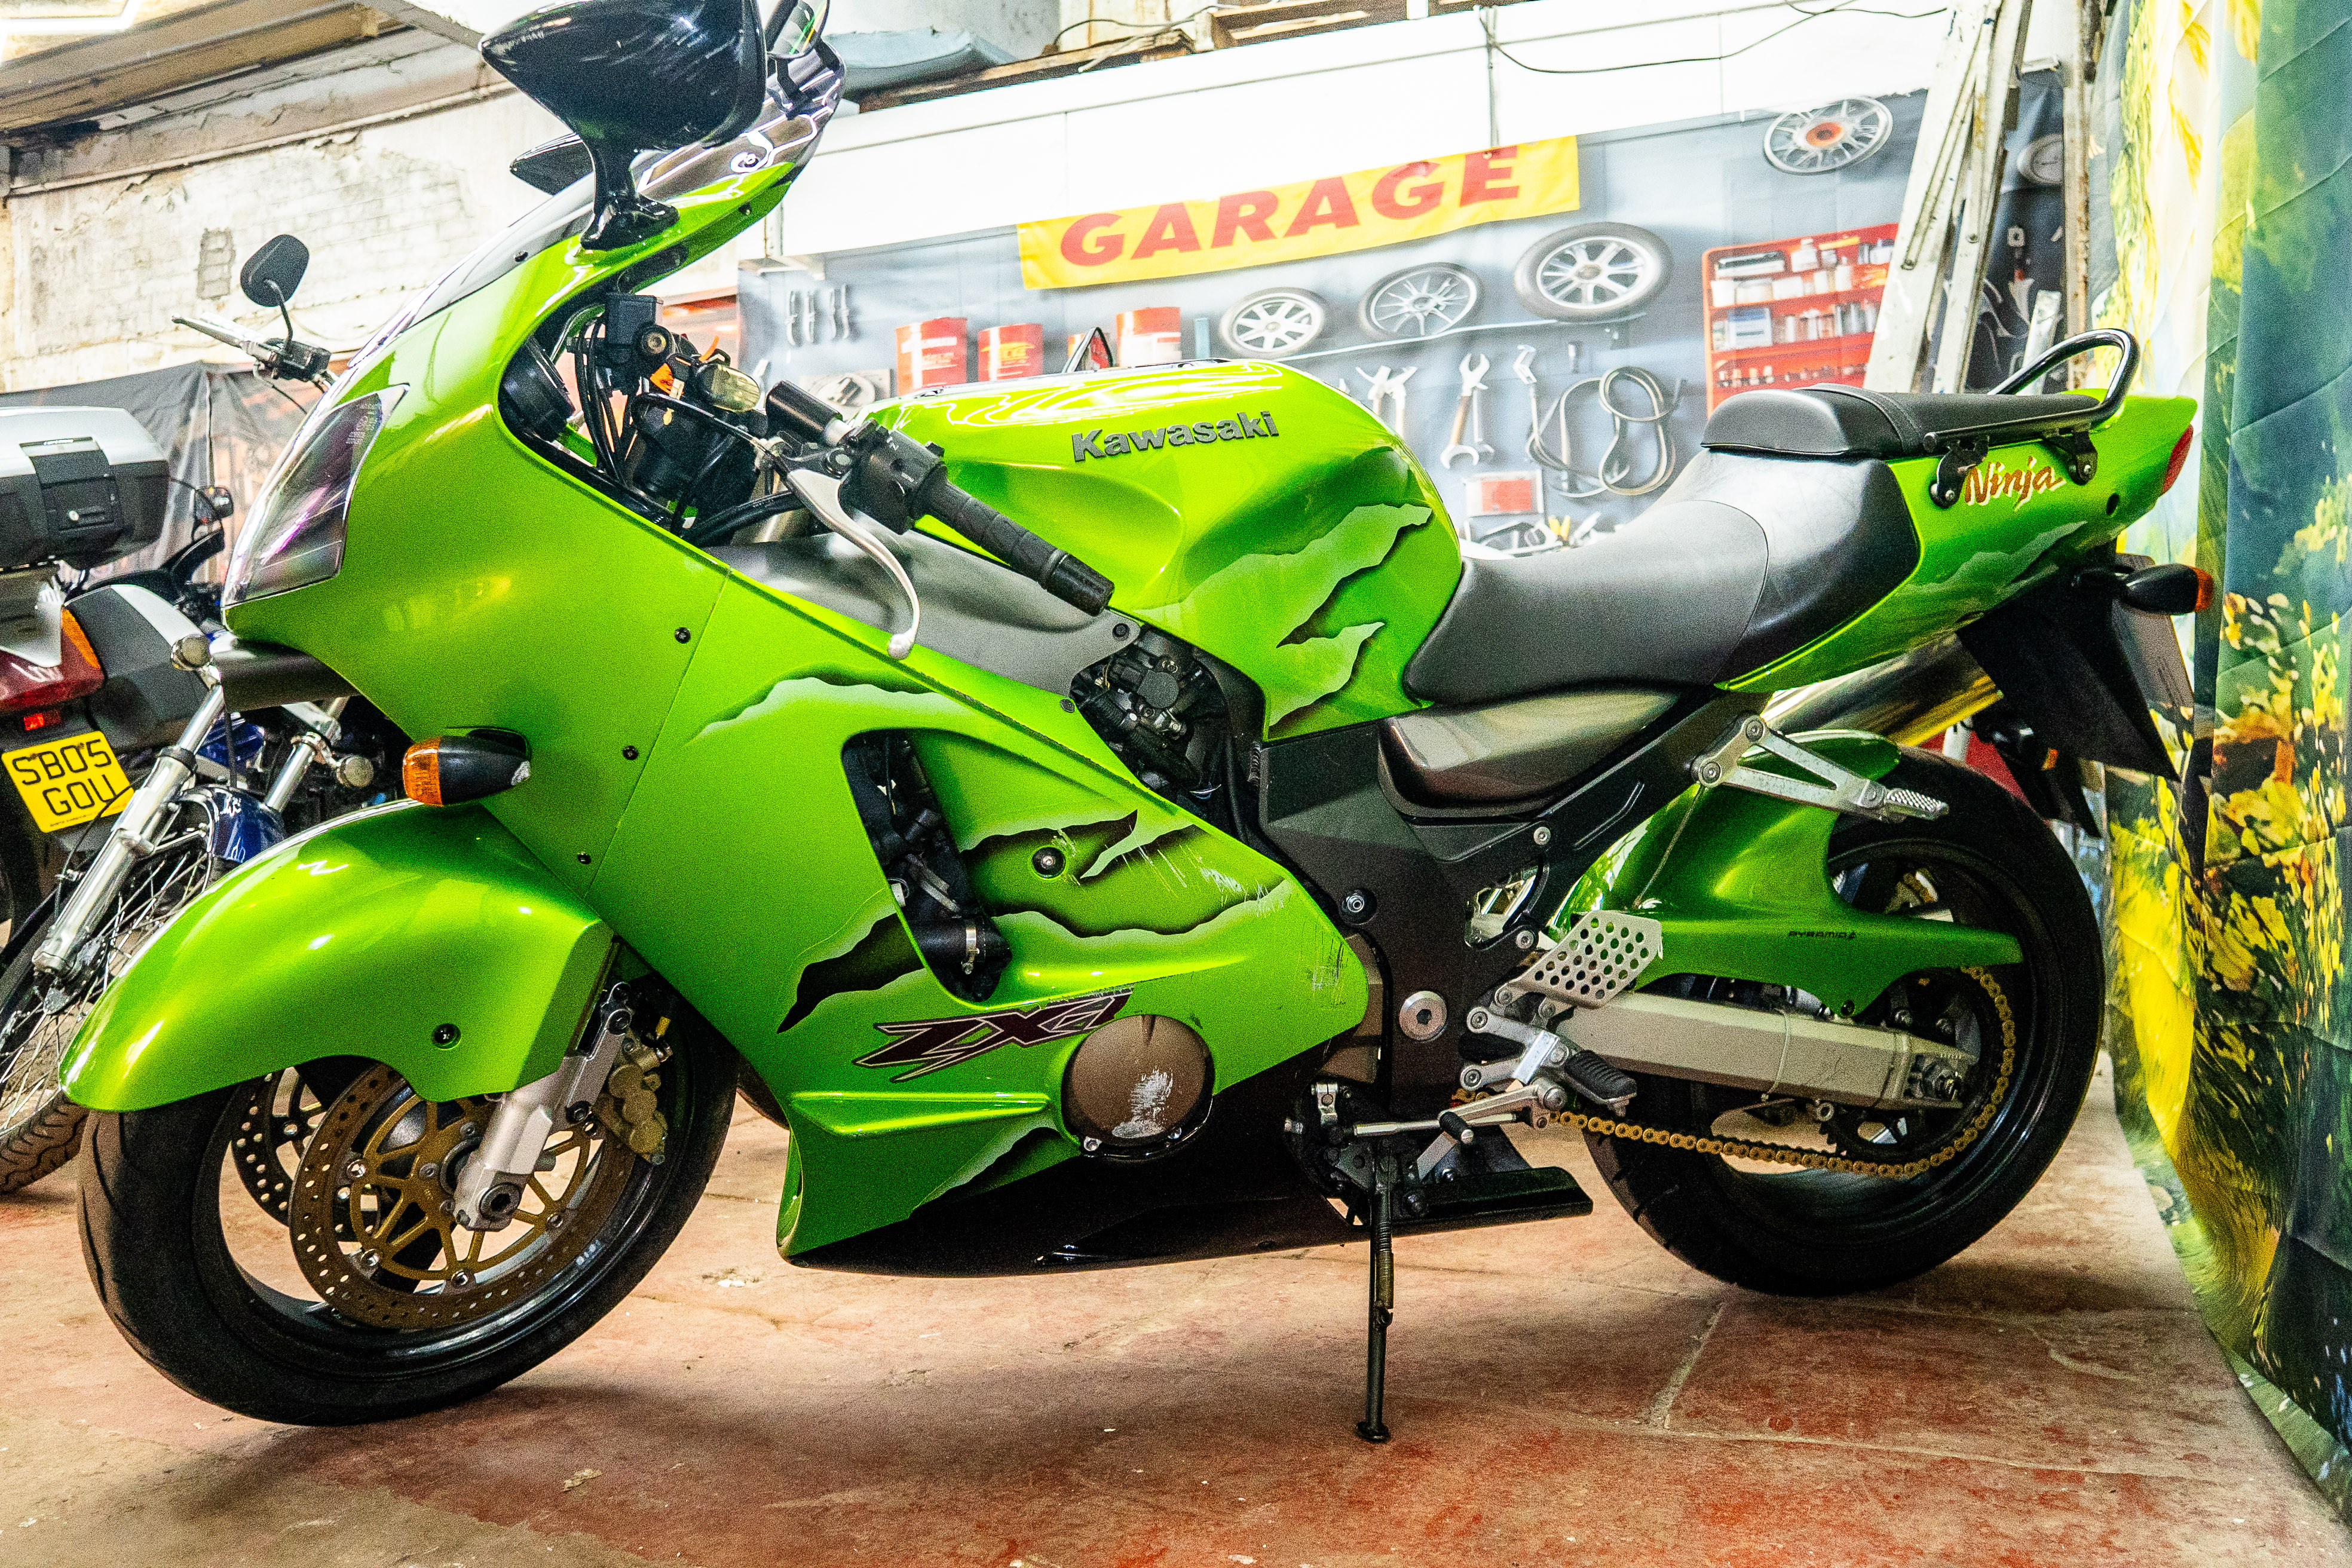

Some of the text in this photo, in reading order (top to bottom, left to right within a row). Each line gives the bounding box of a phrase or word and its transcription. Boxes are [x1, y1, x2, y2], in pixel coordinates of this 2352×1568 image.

[1060, 145, 1520, 267] GARAGE
[1071, 410, 1279, 463] Kawasaki
[1964, 455, 2067, 512] Ninja
[42, 774, 117, 816] GOU
